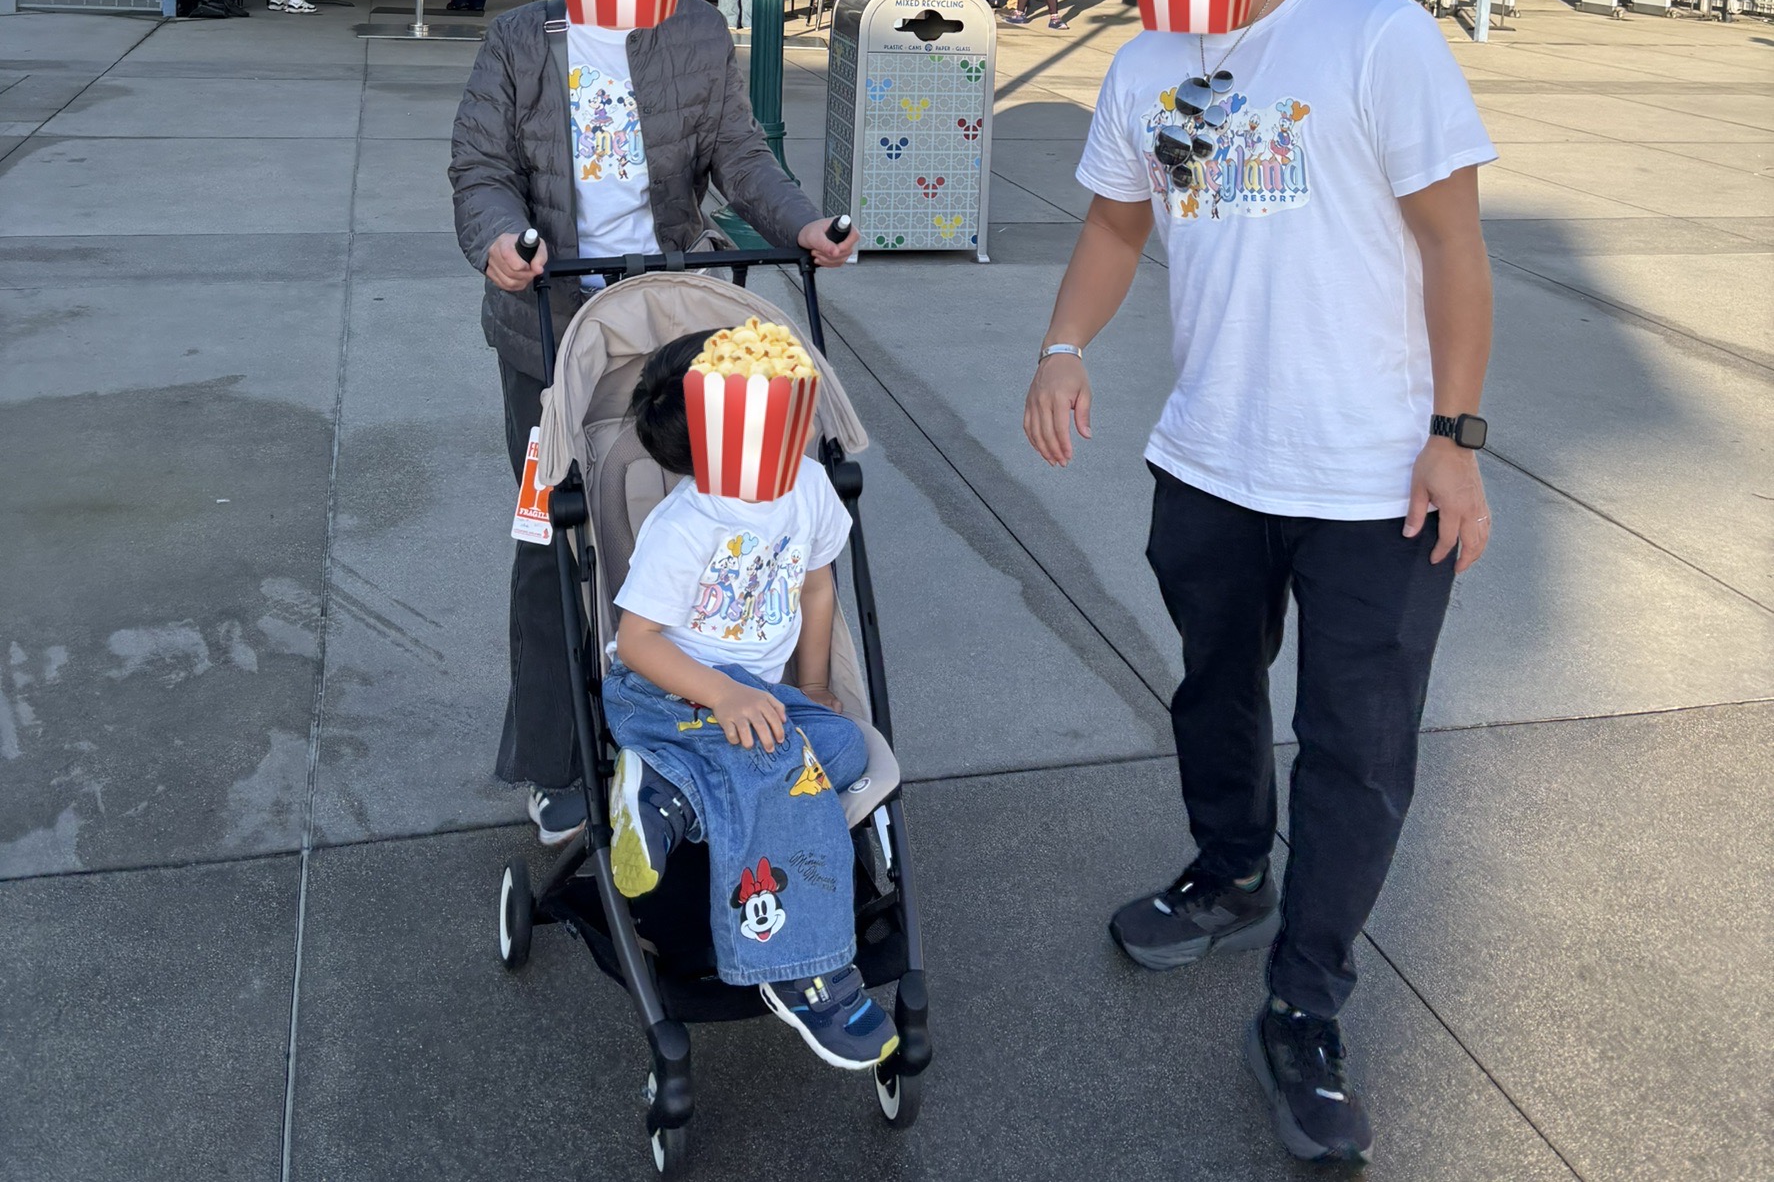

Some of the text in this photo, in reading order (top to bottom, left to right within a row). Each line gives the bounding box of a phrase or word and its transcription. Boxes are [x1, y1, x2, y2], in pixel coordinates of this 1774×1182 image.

[895, 0, 964, 8] MIXED RECYCLING
[1242, 193, 1297, 203] RESORT
